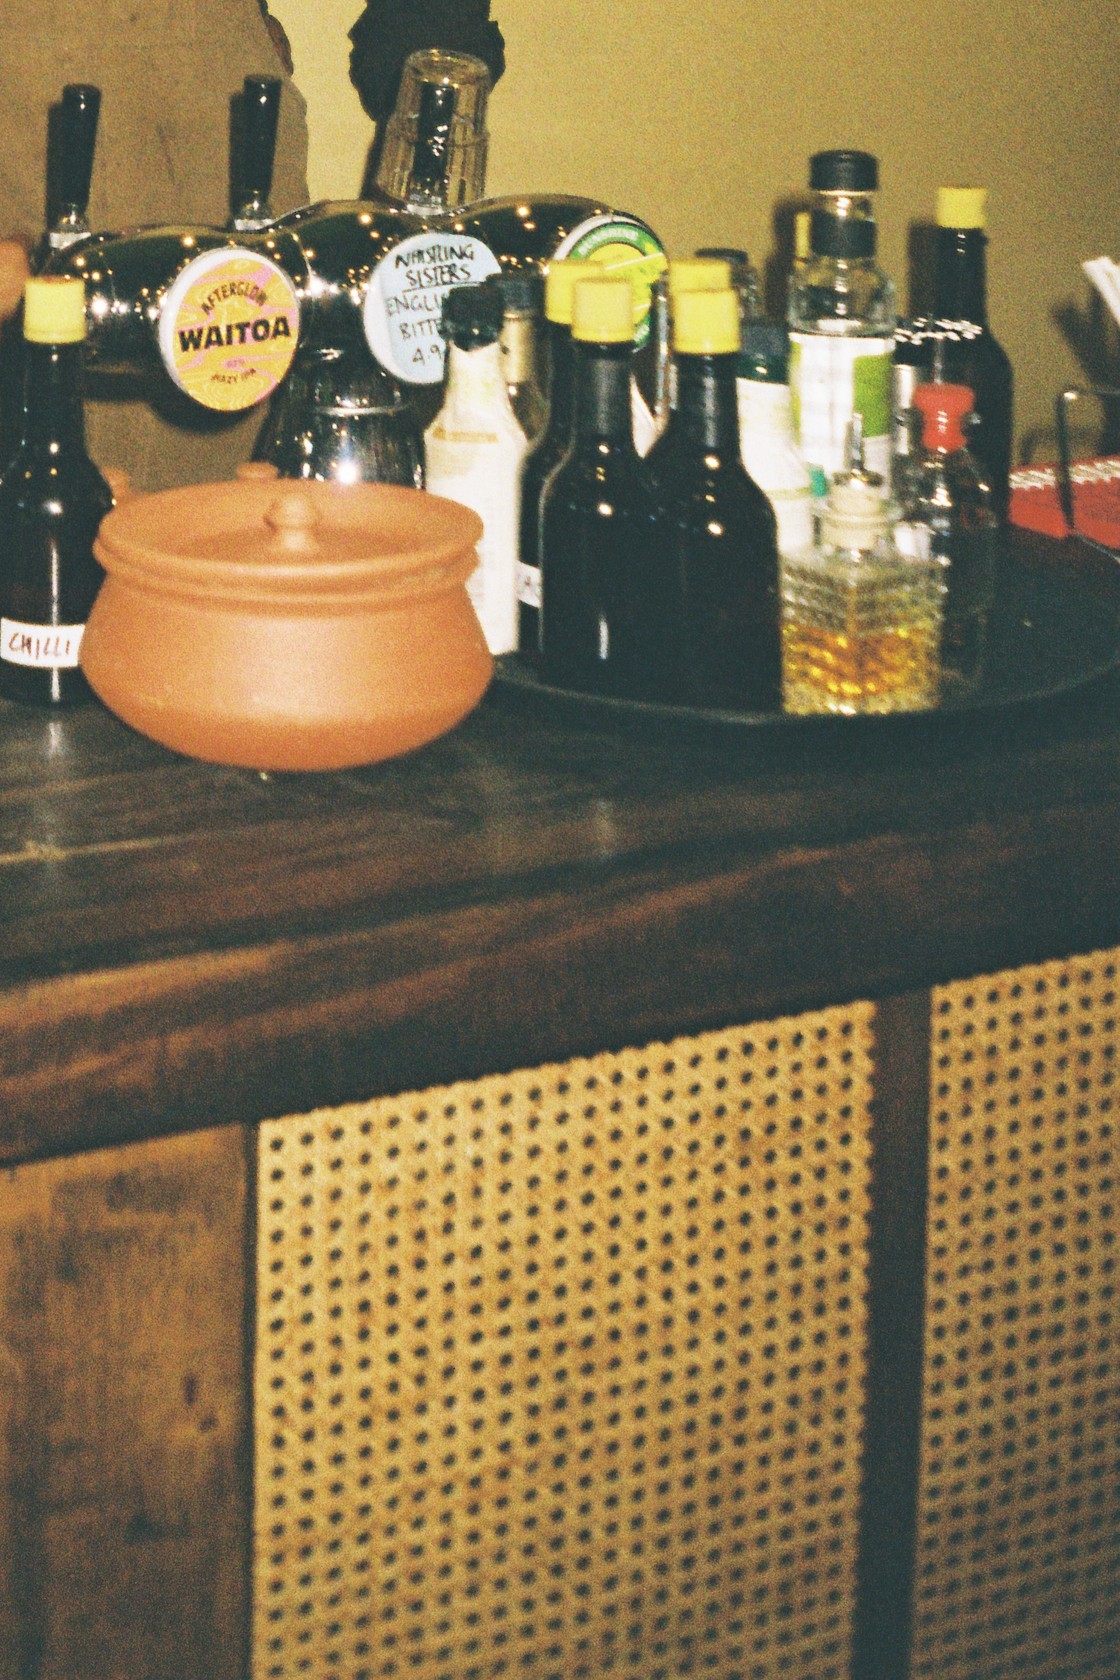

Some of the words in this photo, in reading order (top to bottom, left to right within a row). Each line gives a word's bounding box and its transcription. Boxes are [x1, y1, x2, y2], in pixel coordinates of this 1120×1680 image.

[406, 263, 471, 288] SISTERS
[386, 290, 447, 317] ENGLI
[178, 316, 291, 353] WAITOA
[8, 631, 72, 661] CHILLI
